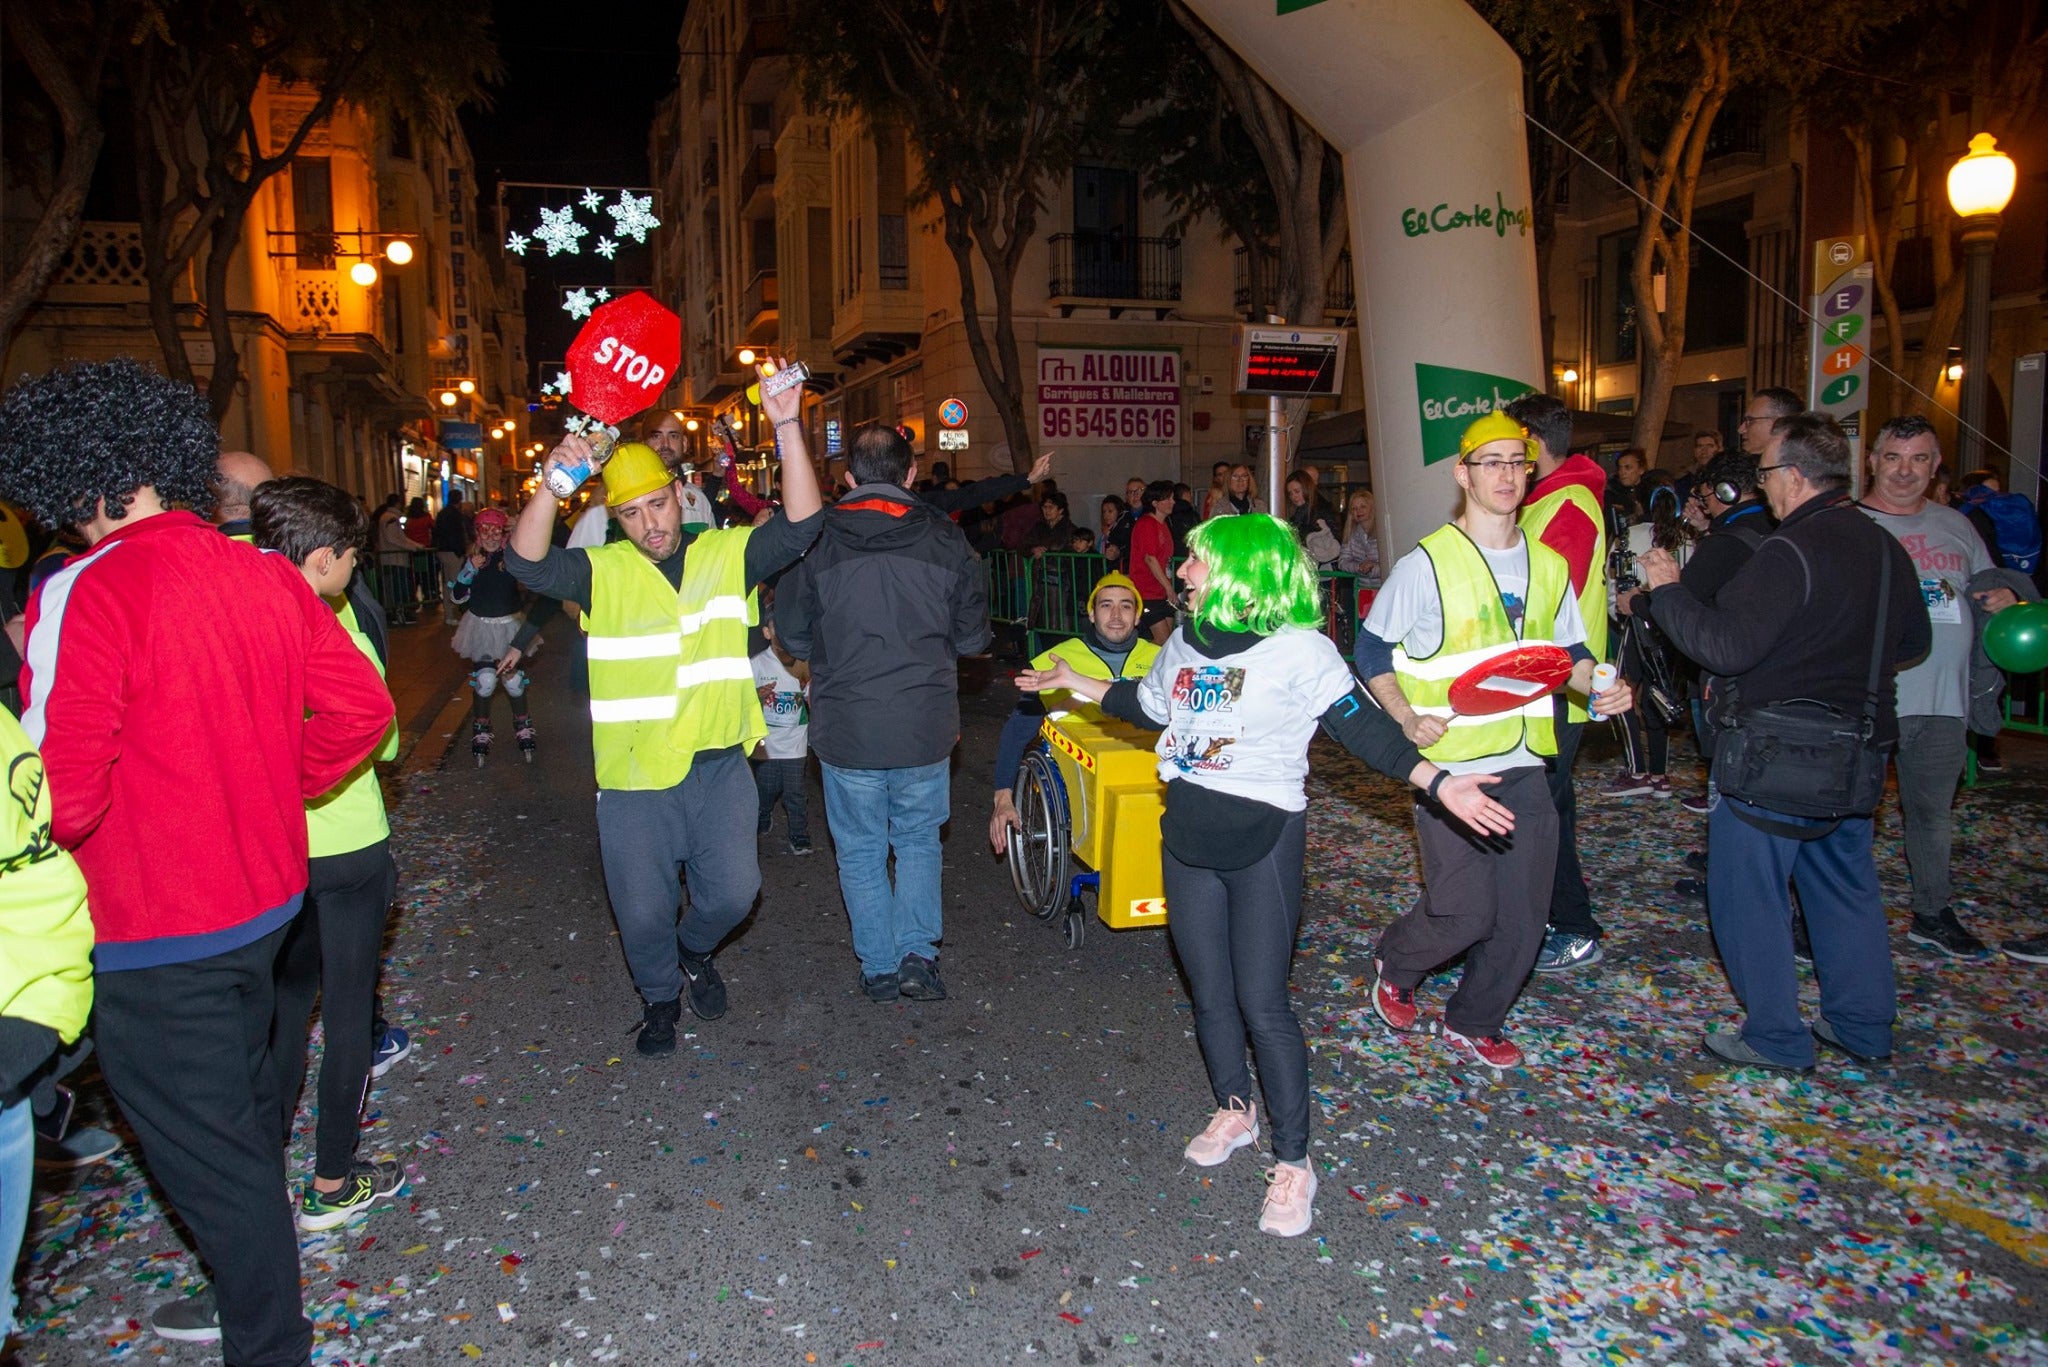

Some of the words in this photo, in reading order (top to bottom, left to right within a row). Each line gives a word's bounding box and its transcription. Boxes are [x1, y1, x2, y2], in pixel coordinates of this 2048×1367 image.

[1402, 208, 1430, 237] El
[1431, 203, 1493, 233] Corte
[1836, 292, 1850, 310] E
[1837, 322, 1850, 339] F
[593, 336, 665, 390] STOP
[1082, 354, 1176, 382] ALQUILA
[1836, 352, 1851, 369] H
[1043, 386, 1099, 402] Garrigues
[1102, 387, 1111, 400] &
[1113, 387, 1175, 401] Mallebrera
[1837, 380, 1849, 397] J
[1423, 398, 1444, 420] El
[1444, 396, 1492, 418] Corte
[1177, 687, 1233, 713] 2002
